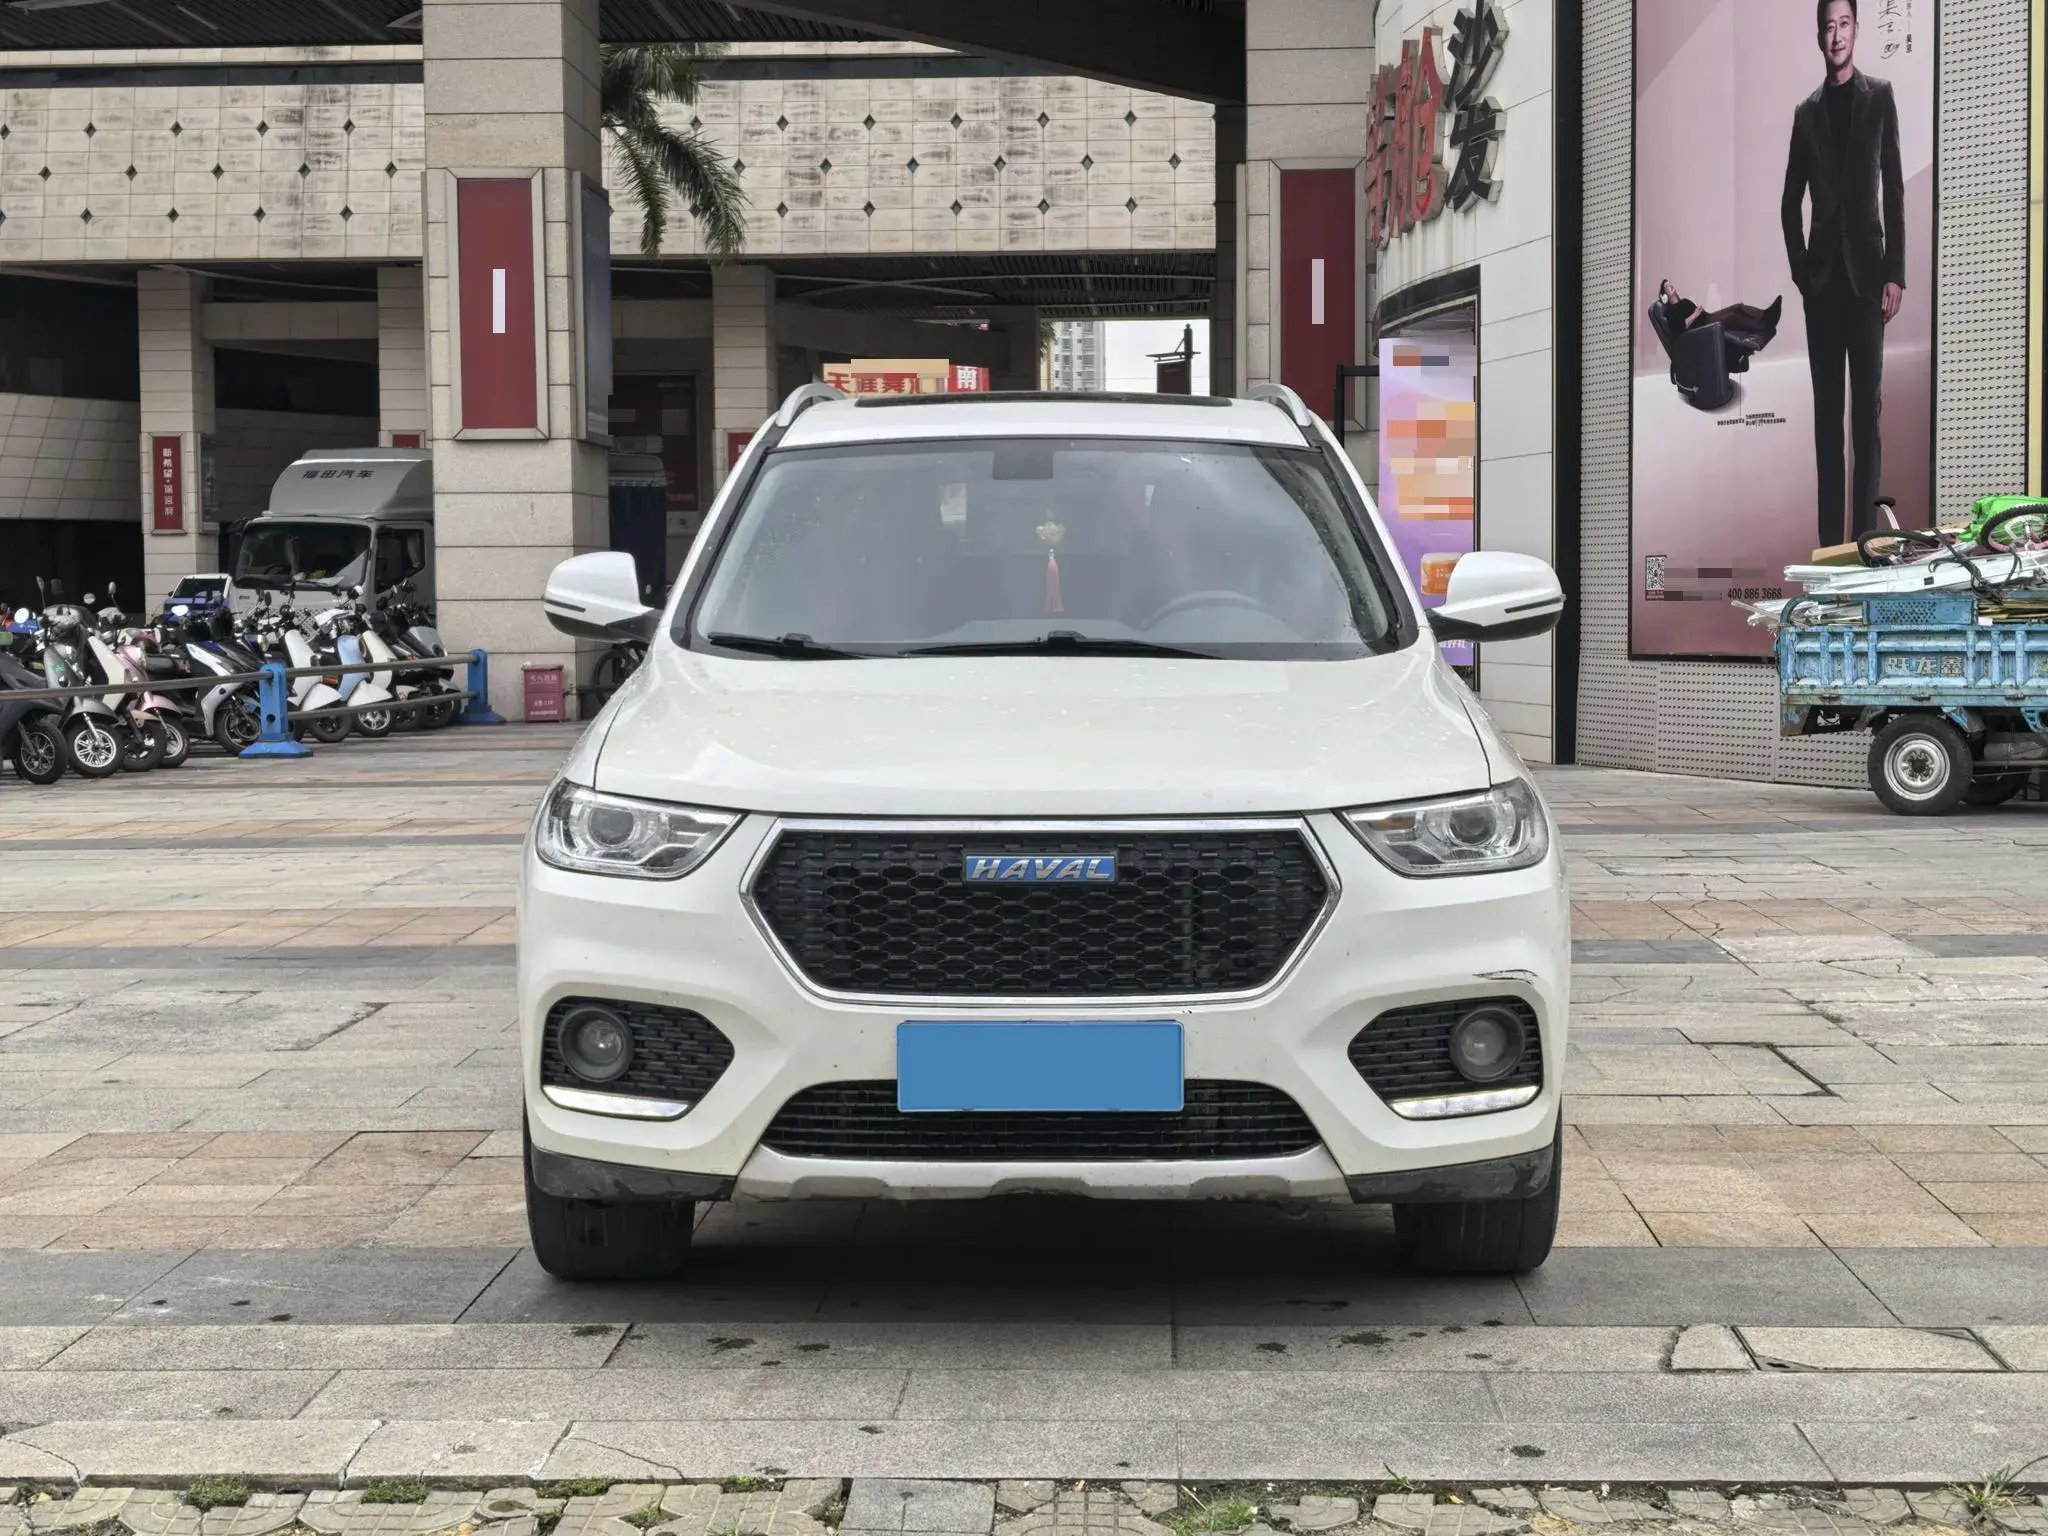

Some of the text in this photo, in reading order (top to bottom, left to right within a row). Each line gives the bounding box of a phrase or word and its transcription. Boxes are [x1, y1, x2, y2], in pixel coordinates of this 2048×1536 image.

[1445, 0, 1508, 212] 沙发
[302, 468, 376, 480] 福田汽车
[1727, 588, 1782, 600] 400 886 3668
[971, 859, 1110, 879] HAVAL
